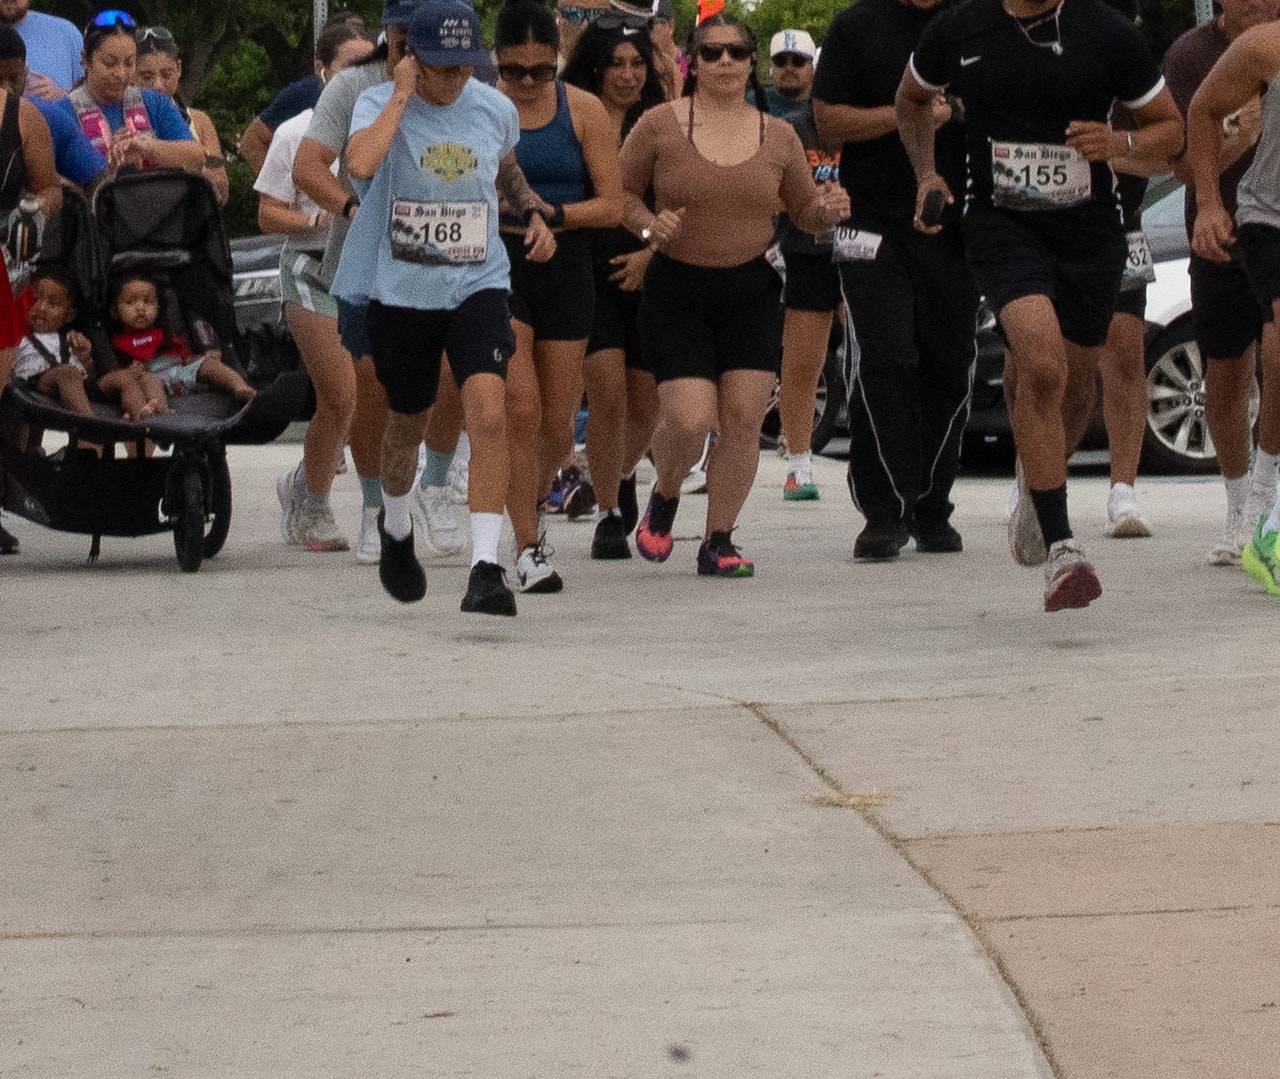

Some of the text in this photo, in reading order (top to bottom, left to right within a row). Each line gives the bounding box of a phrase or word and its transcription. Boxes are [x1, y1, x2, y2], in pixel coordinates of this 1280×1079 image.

[1013, 147, 1037, 160] San
[1020, 164, 1068, 187] 155
[414, 205, 437, 217] San
[419, 222, 462, 244] 168
